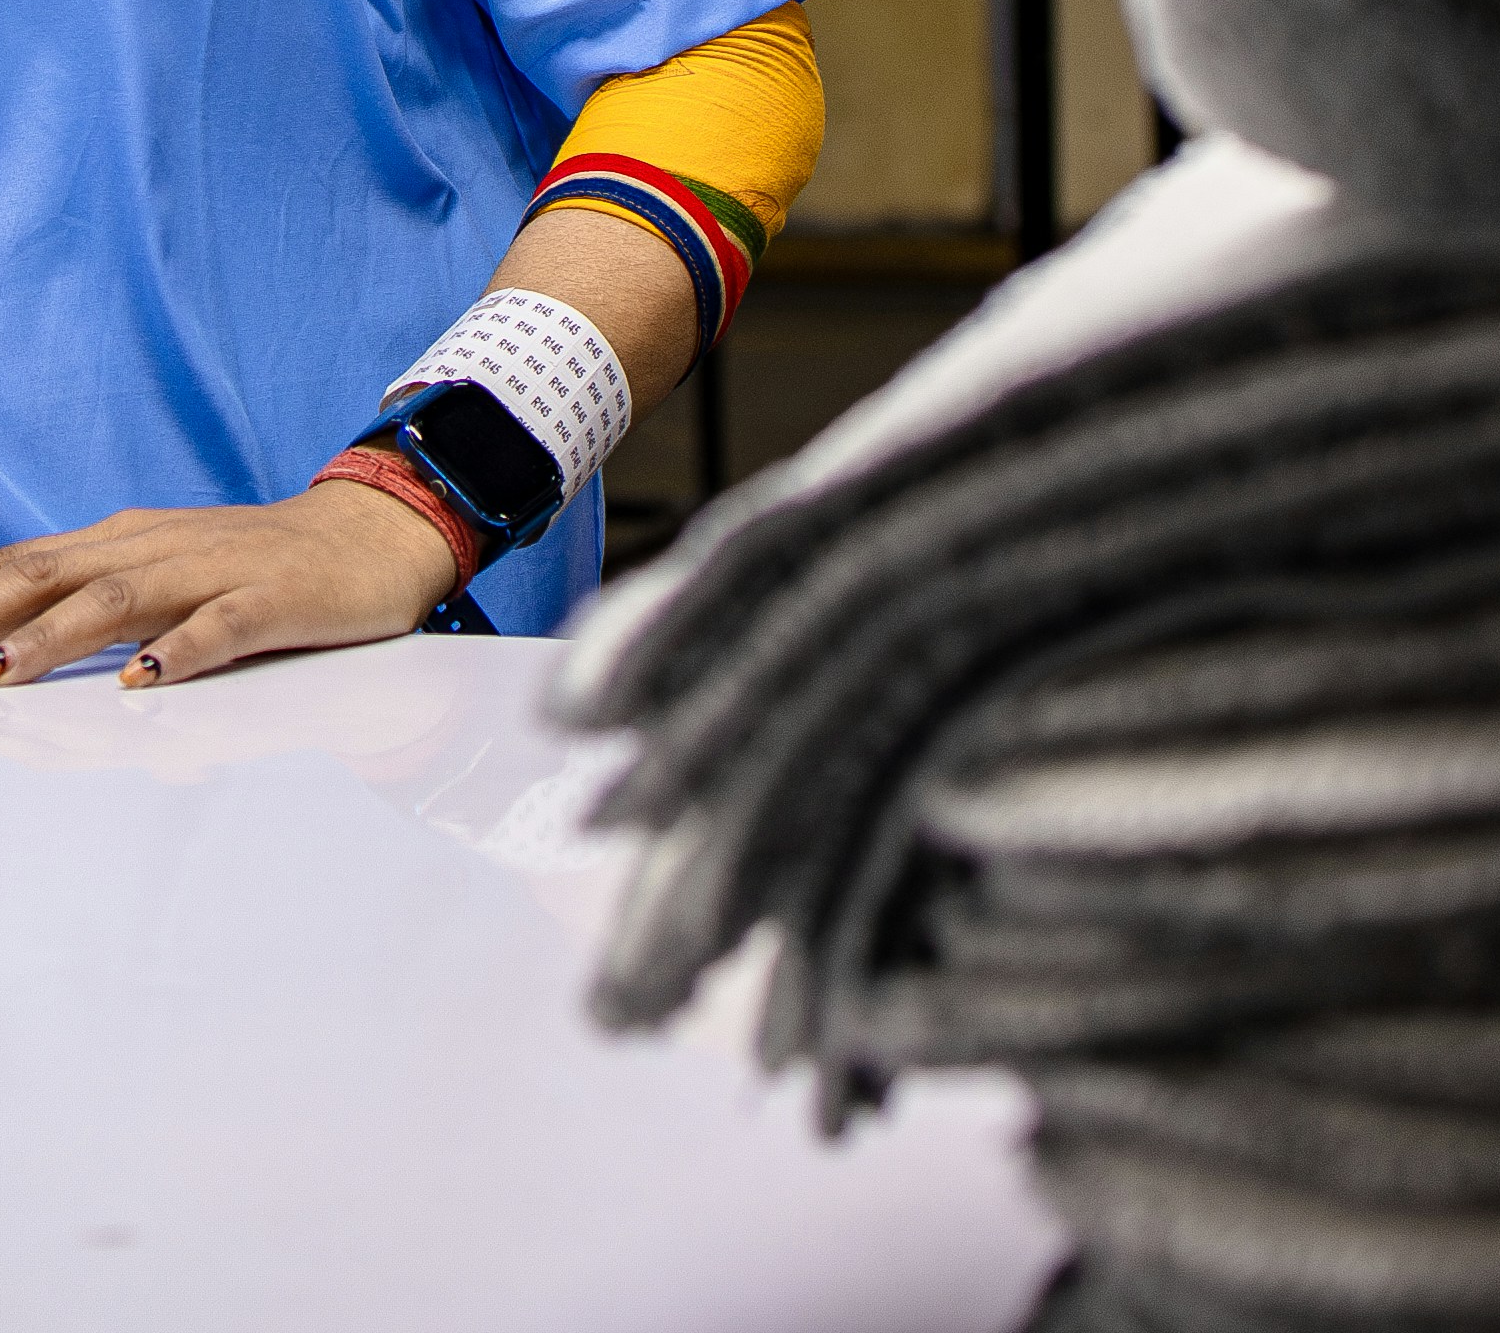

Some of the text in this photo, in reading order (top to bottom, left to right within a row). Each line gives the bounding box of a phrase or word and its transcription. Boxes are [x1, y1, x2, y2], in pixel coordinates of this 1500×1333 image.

[497, 338, 520, 355] R145
[523, 355, 547, 375] R145
[548, 376, 570, 398] R145
[570, 400, 588, 424] R145
[506, 296, 528, 307] R145
[531, 303, 555, 318] R145
[558, 316, 581, 336] R145
[583, 337, 604, 360] R145
[602, 362, 618, 386] R145
[514, 320, 538, 336] R145
[541, 335, 564, 355] R145
[566, 356, 587, 379] R145
[586, 381, 603, 405] R145
[478, 356, 503, 375] R145
[505, 375, 528, 395] R145
[530, 395, 552, 418] R145
[552, 419, 572, 444] R145
